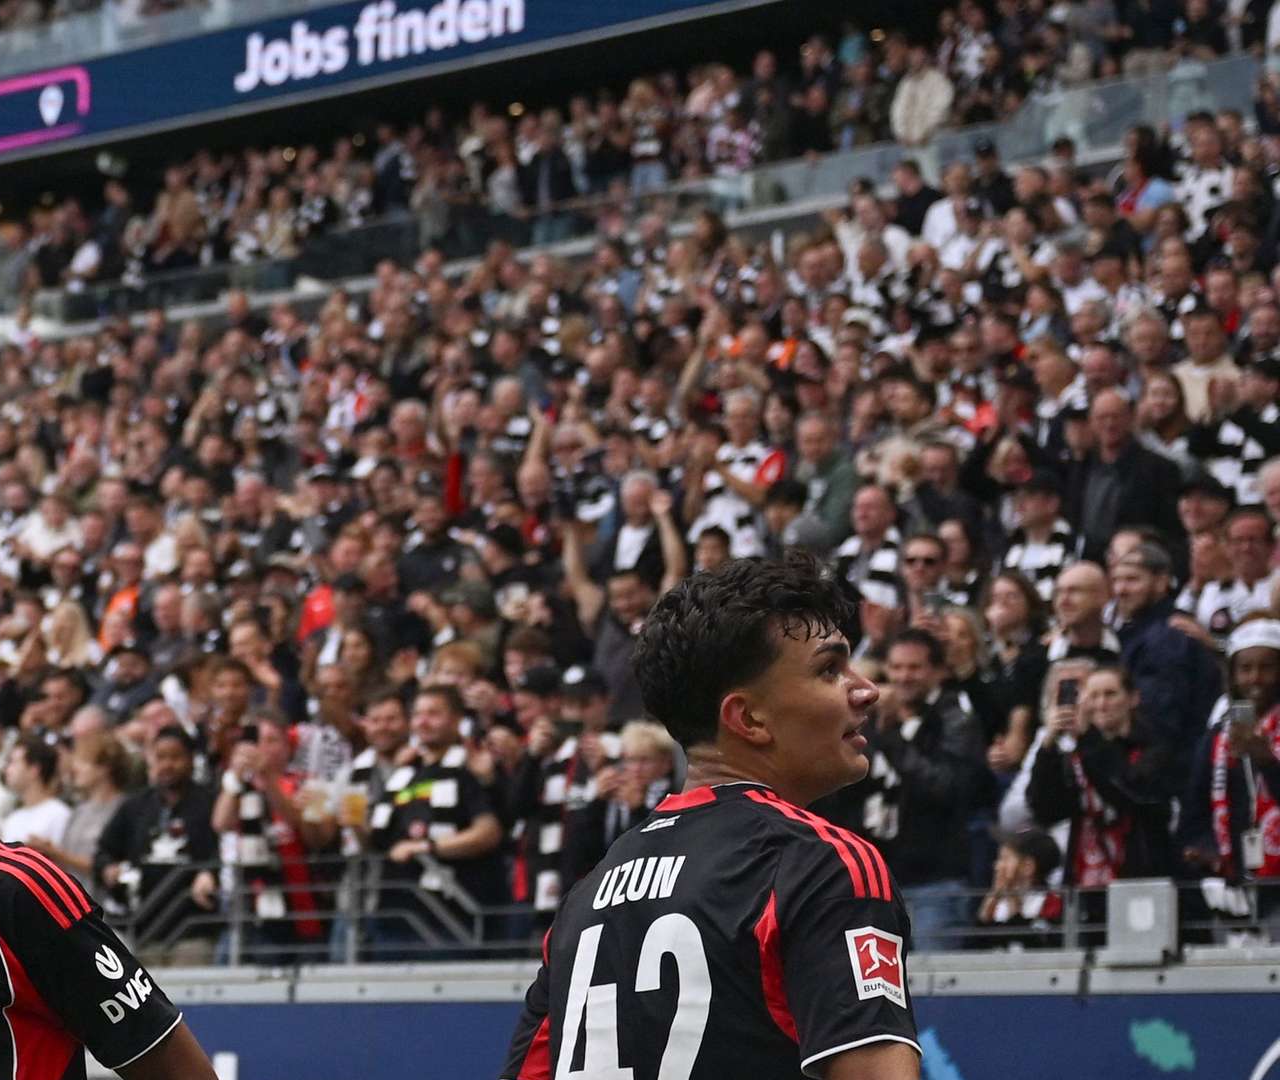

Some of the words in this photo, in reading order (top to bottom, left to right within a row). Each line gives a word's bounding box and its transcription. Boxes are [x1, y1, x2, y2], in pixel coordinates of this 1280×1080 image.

[235, 22, 346, 92] Jobs
[354, 0, 524, 64] finden
[593, 856, 686, 910] UZUN
[100, 967, 152, 1024] DVAG
